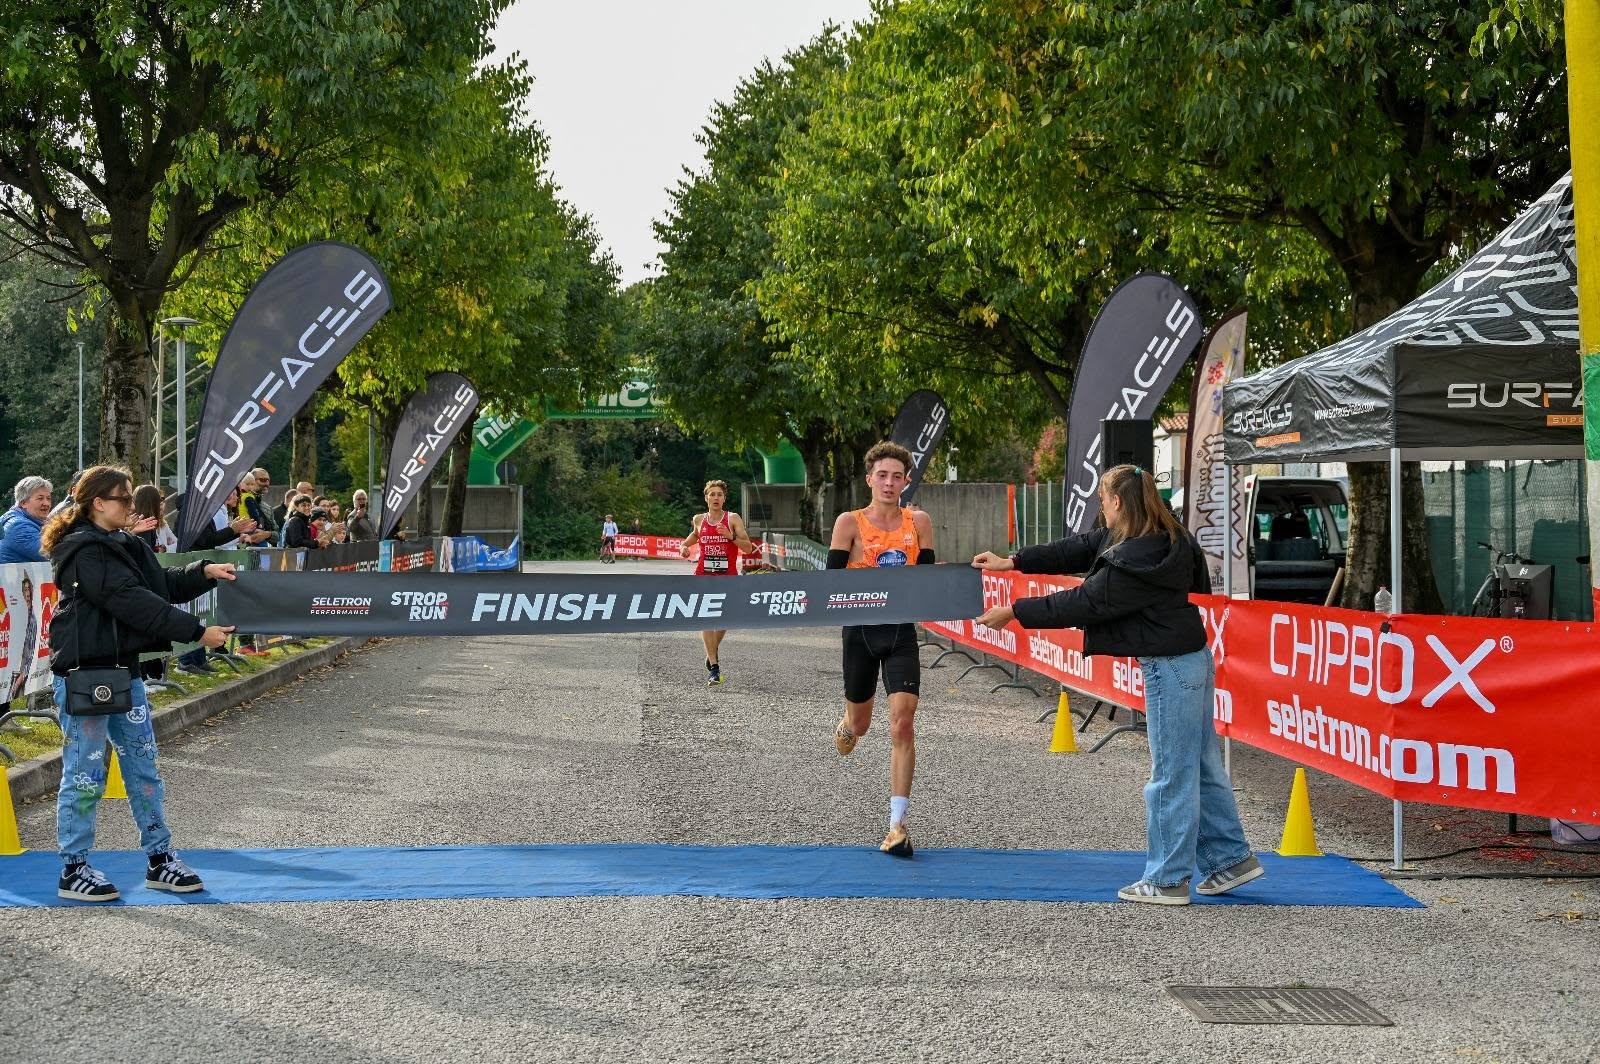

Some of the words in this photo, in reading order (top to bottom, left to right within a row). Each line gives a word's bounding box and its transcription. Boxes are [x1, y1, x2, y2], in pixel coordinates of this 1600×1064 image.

[194, 269, 382, 499] SURFACES
[1232, 402, 1294, 434] SURFACES
[386, 383, 474, 512] SURFACES
[615, 536, 648, 547] HIPBOX
[656, 538, 685, 550] CHIPB
[311, 597, 372, 606] SELETRON
[391, 591, 447, 606] STROP
[750, 590, 807, 604] STROP
[829, 591, 888, 602] SELETRON
[408, 605, 447, 620] RUN
[471, 593, 617, 622] FINISH
[626, 593, 727, 620] LINE
[768, 602, 806, 616] RUN
[1029, 631, 1093, 681] seletron.com
[1266, 694, 1516, 794] seletron.com
